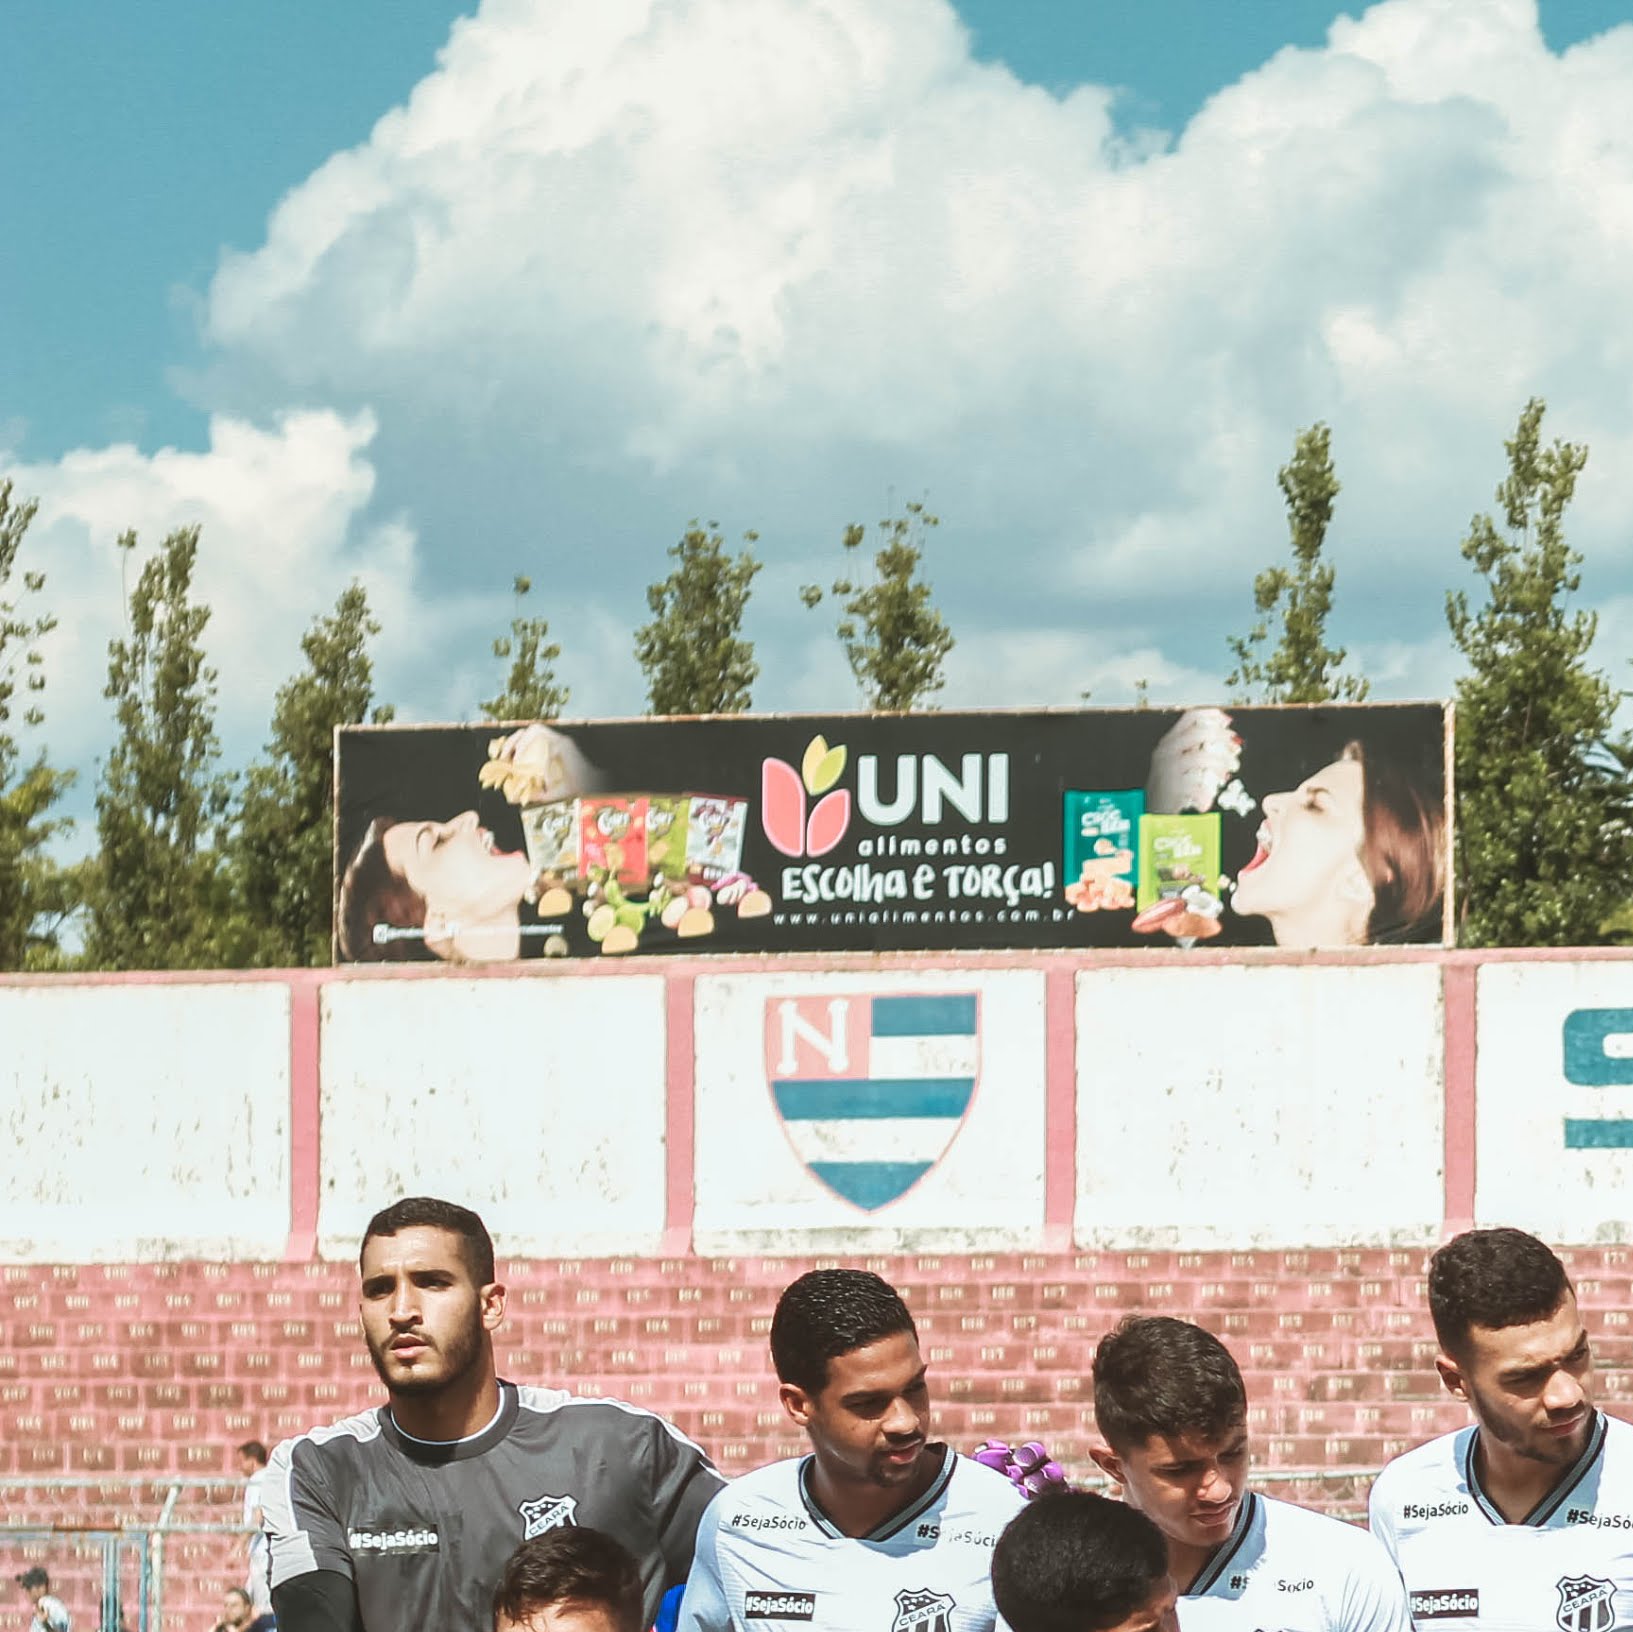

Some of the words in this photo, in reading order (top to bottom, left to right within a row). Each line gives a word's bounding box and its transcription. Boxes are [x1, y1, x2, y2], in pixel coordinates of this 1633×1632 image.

[858, 753, 1009, 826] UNI
[858, 836, 1007, 856] alimentos
[774, 908, 1075, 926] www.unialimentos.com.br
[778, 999, 850, 1076] N
[1403, 1501, 1469, 1519] #SejaSócio
[732, 1512, 807, 1532] #SejaSócio
[350, 1527, 438, 1552] #SejaSócio
[746, 1594, 815, 1616] #SejaSócio
